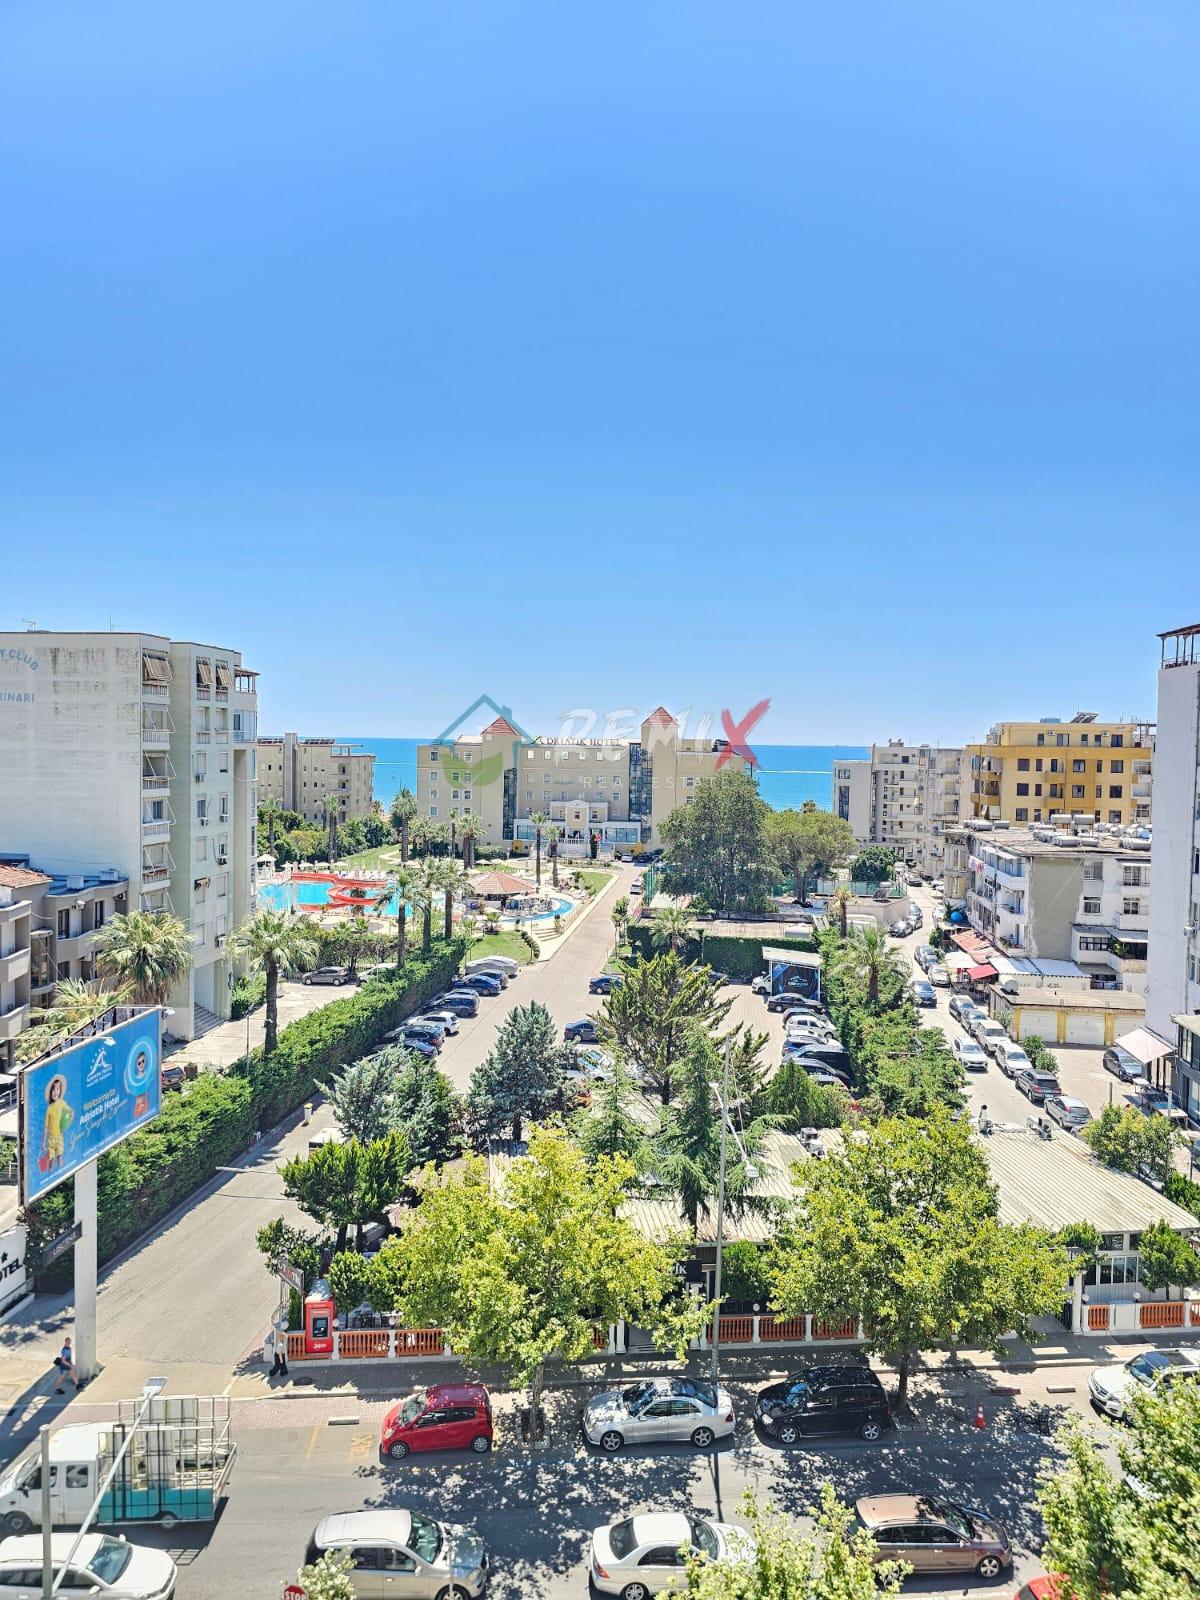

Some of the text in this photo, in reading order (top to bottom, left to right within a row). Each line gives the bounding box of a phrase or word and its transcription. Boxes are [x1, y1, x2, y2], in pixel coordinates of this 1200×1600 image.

[9, 649, 39, 670] CLUB
[590, 738, 622, 746] HOTEL
[285, 1590, 306, 1600] STOP
